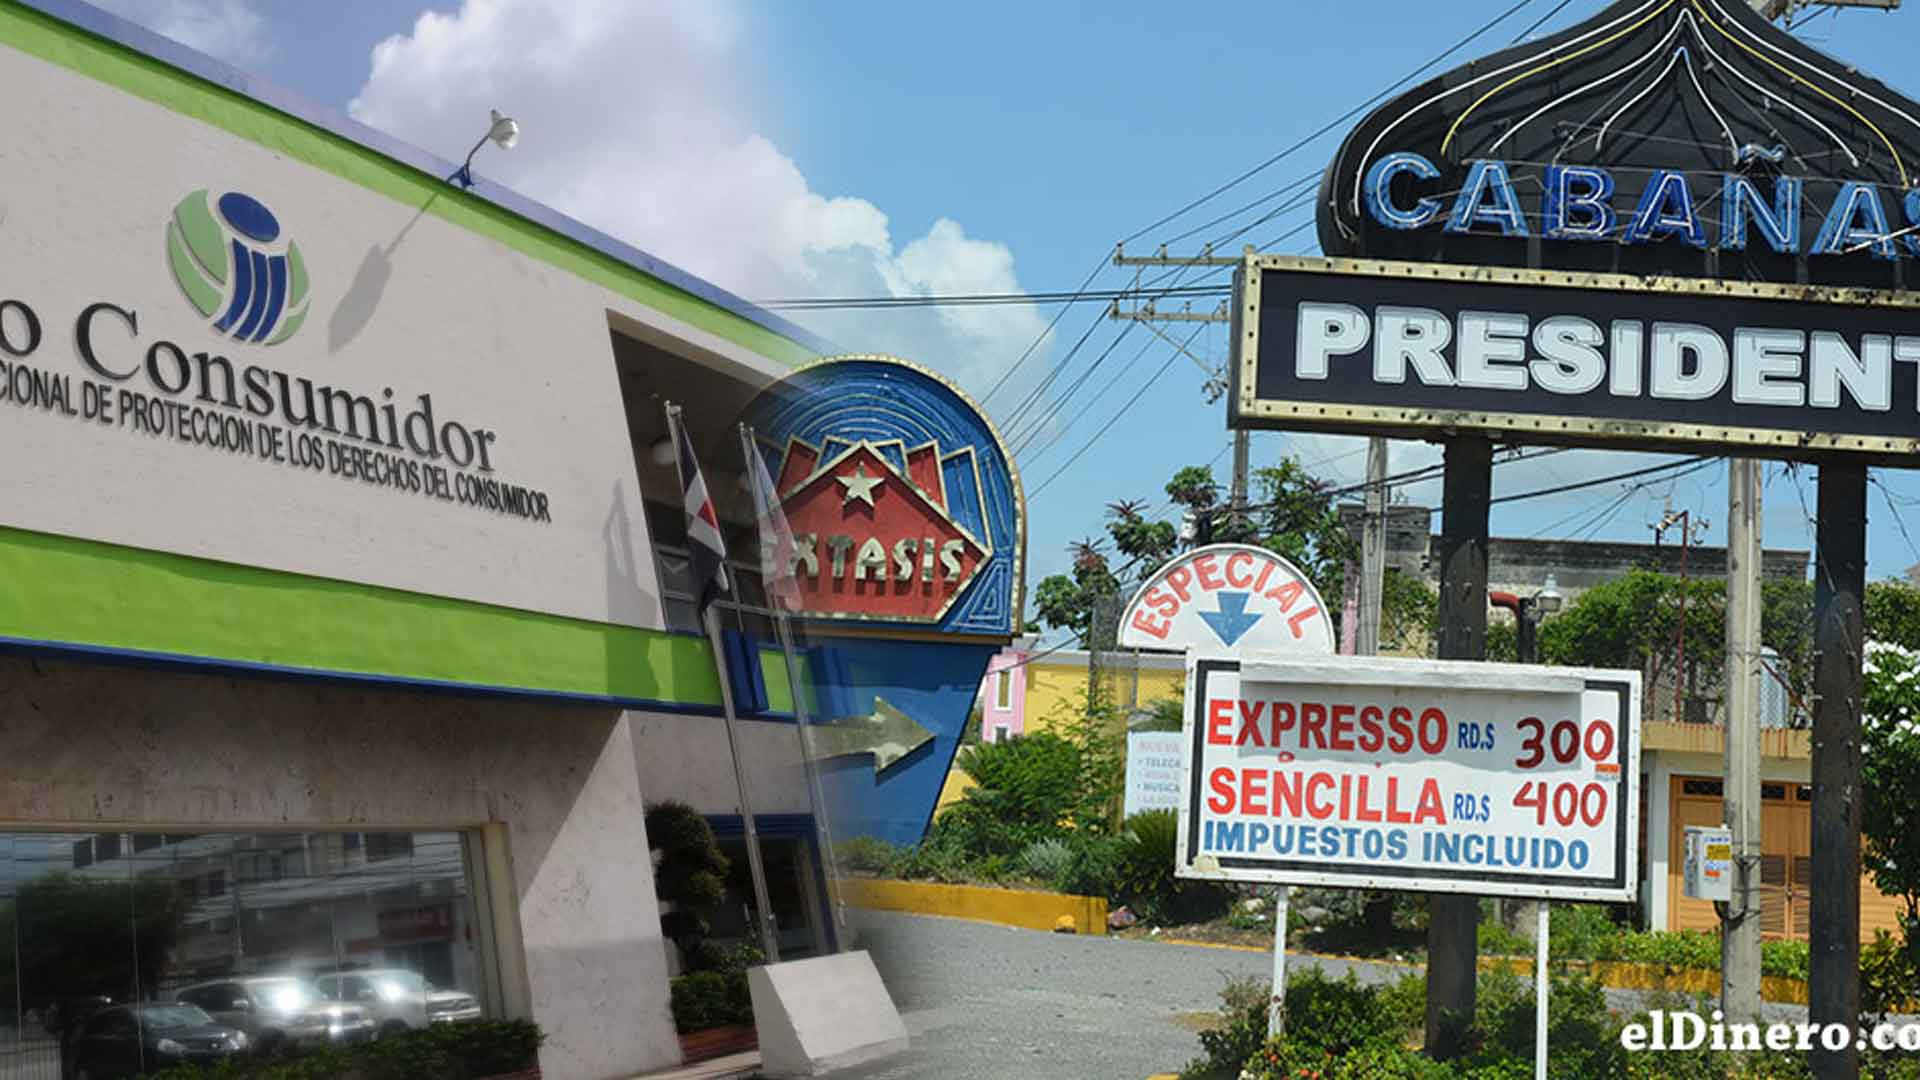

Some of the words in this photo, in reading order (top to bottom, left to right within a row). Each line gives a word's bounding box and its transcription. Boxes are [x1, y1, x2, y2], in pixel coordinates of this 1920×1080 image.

[76, 302, 497, 472] Consumidor
[83, 380, 114, 425] DE
[119, 389, 254, 455] PROTECCION
[258, 422, 286, 463] DE
[288, 428, 325, 471] LOS
[327, 439, 421, 493] DERECHOS
[423, 462, 455, 502] DEL
[455, 471, 552, 523] CONSUMIDOR
[1131, 551, 1320, 640] ESPECIAL
[1207, 699, 1449, 756] EXPRESSO
[1514, 716, 1614, 769] 300
[1207, 766, 1448, 826] SENCILLA
[1513, 780, 1609, 828] 400
[1203, 819, 1409, 861] IMPUESTOS
[1423, 831, 1590, 871] INCLUIDO
